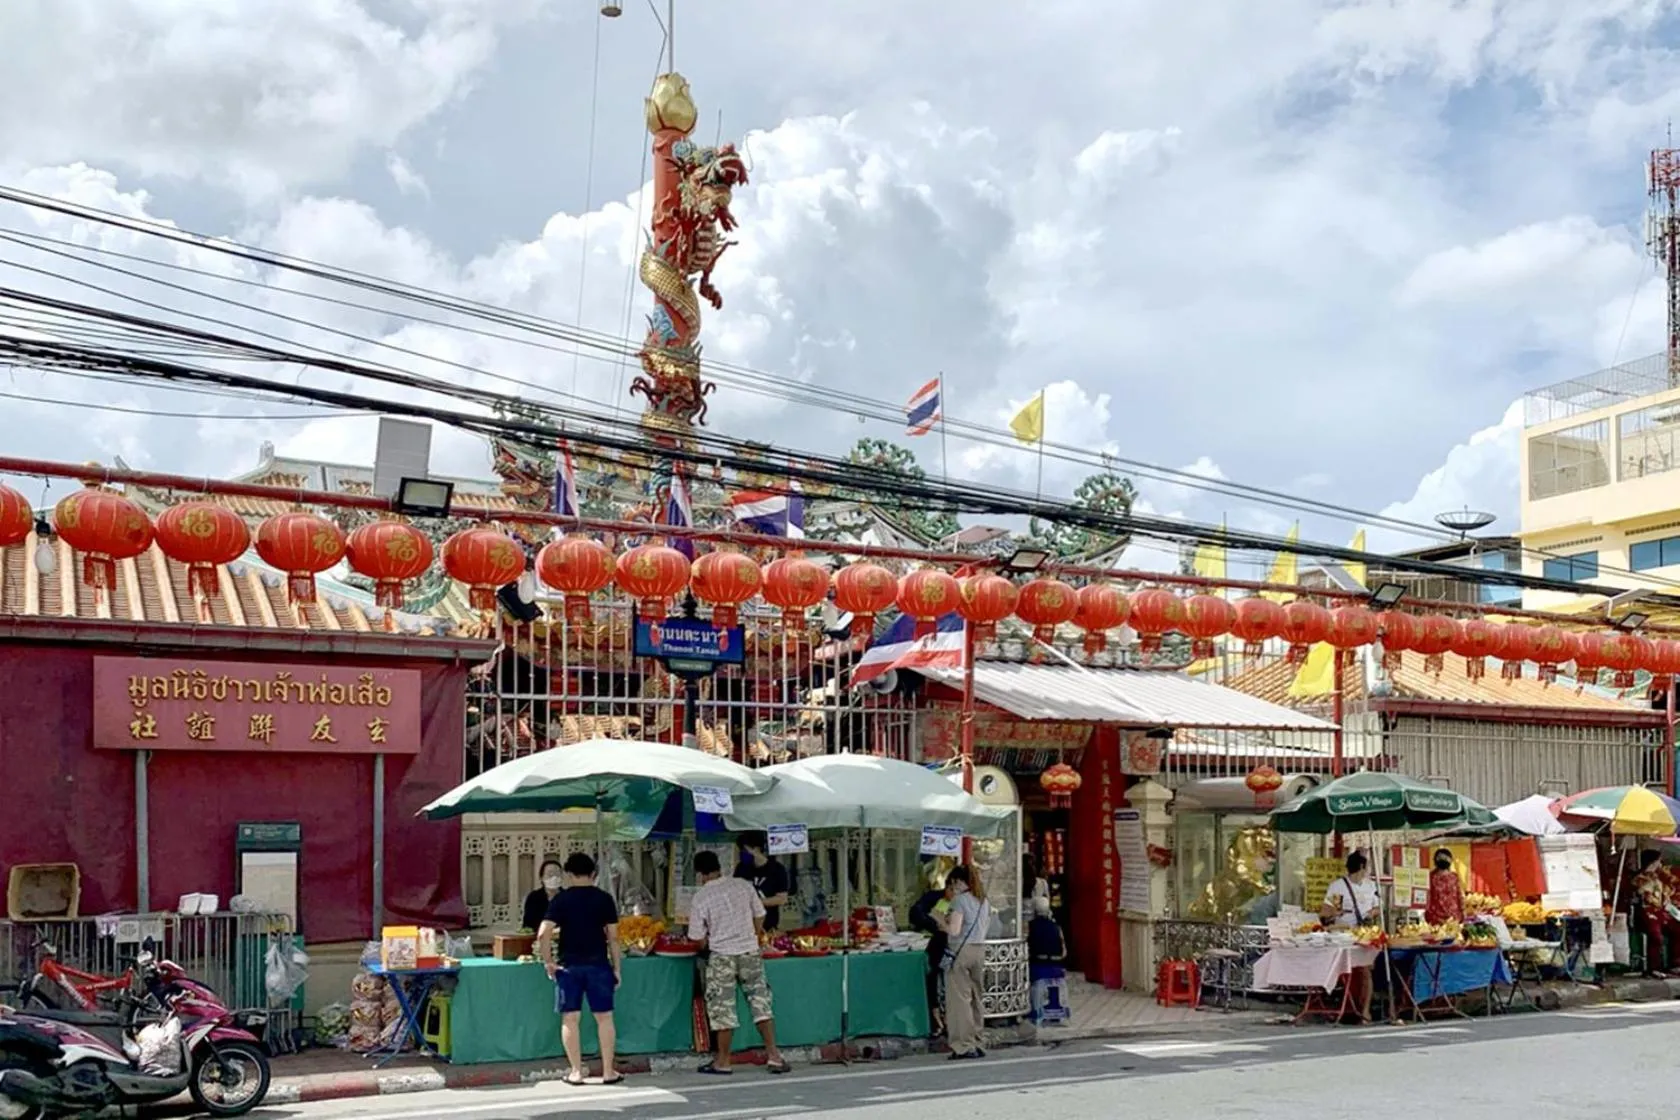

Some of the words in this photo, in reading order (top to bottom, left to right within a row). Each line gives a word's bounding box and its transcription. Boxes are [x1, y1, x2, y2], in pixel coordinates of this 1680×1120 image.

[657, 627, 718, 643] ถนนตะนา
[128, 668, 392, 707] มูลนิธิชาวเจ้าพ่อเสือ
